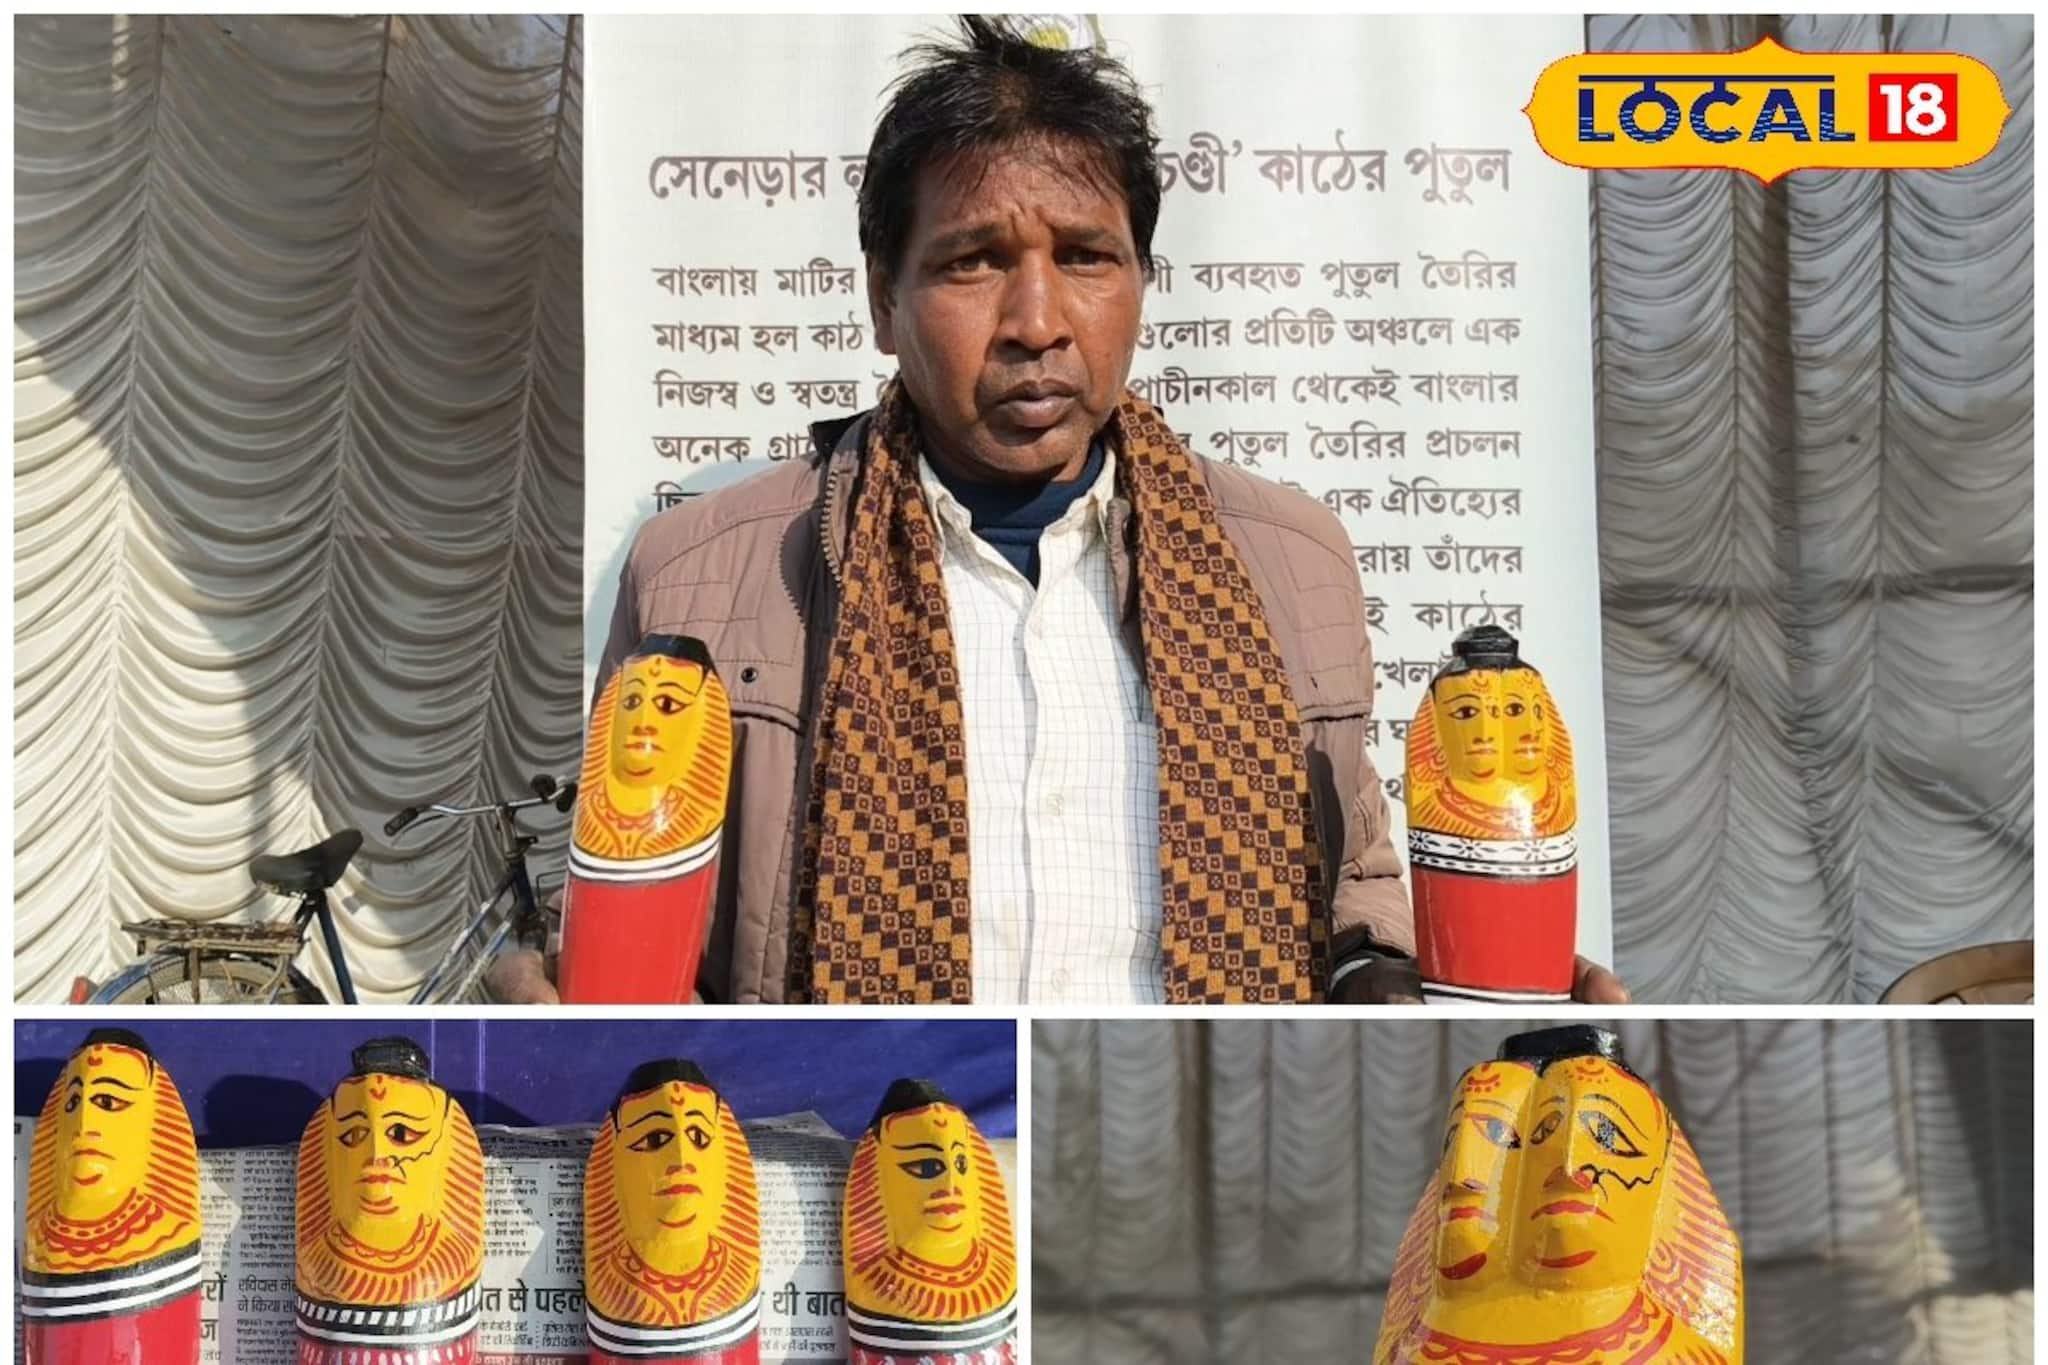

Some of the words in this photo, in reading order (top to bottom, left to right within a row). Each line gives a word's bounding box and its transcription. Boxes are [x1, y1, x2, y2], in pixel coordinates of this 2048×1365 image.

[649, 151, 828, 207] সেনেড়ার
[1253, 130, 1387, 194] কাঠের
[1404, 143, 1511, 204] পুতুল
[652, 267, 757, 296] বাংলায়
[774, 257, 856, 296] মাটির
[1190, 262, 1304, 293] ব্যবহৃত
[1320, 259, 1400, 298] পুতুল
[1418, 250, 1518, 290] তৈরির
[652, 322, 740, 354] মাধ্যম
[750, 324, 798, 357] হল
[808, 311, 864, 352] কাঠ
[1244, 307, 1337, 349] প্রতিটি
[1345, 316, 1454, 348] অঞ্চলে
[1465, 316, 1522, 347] এক
[652, 369, 740, 410] নিজস্ব
[751, 379, 776, 407] ও
[787, 380, 860, 411] স্বতন্ত্র
[1129, 366, 1277, 406] প্রাচীনকাল
[1292, 366, 1402, 406] থেকেই
[1410, 372, 1520, 404] বাংলার
[652, 435, 751, 463] অনেক
[1210, 427, 1289, 468] পুতুল
[1305, 420, 1407, 460] তৈরির
[1426, 429, 1521, 461] প্রচলন
[1381, 475, 1522, 519] ঐতিহ্যের
[1423, 534, 1524, 575] তাঁদের
[1411, 589, 1524, 632] কাঠের
[508, 1278, 529, 1312] से
[773, 1281, 800, 1316] थी
